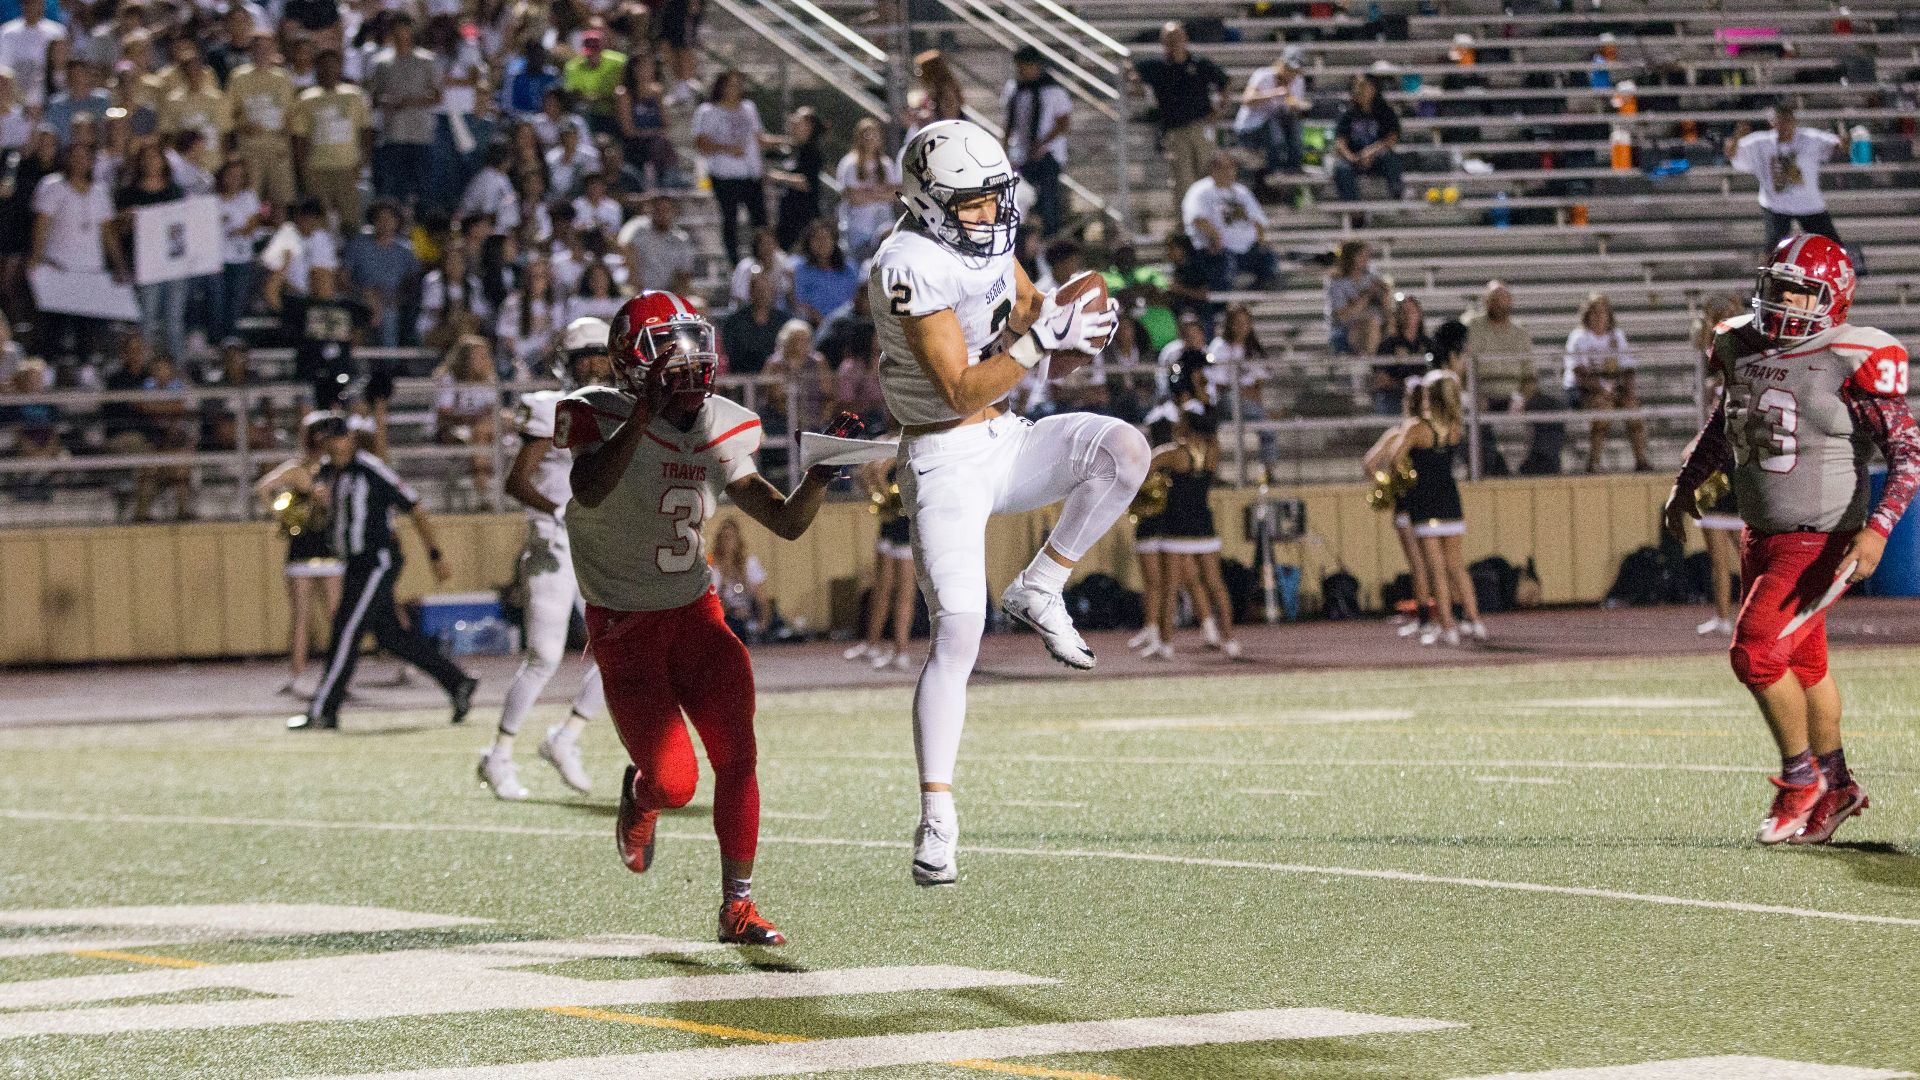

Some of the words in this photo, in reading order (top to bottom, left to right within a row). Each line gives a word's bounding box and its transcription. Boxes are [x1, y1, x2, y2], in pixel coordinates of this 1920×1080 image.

[891, 284, 912, 316] 2
[1744, 363, 1789, 381] TRAVIS
[1874, 358, 1909, 394] 33
[662, 463, 706, 481] TRAVIS
[655, 485, 704, 574] 3
